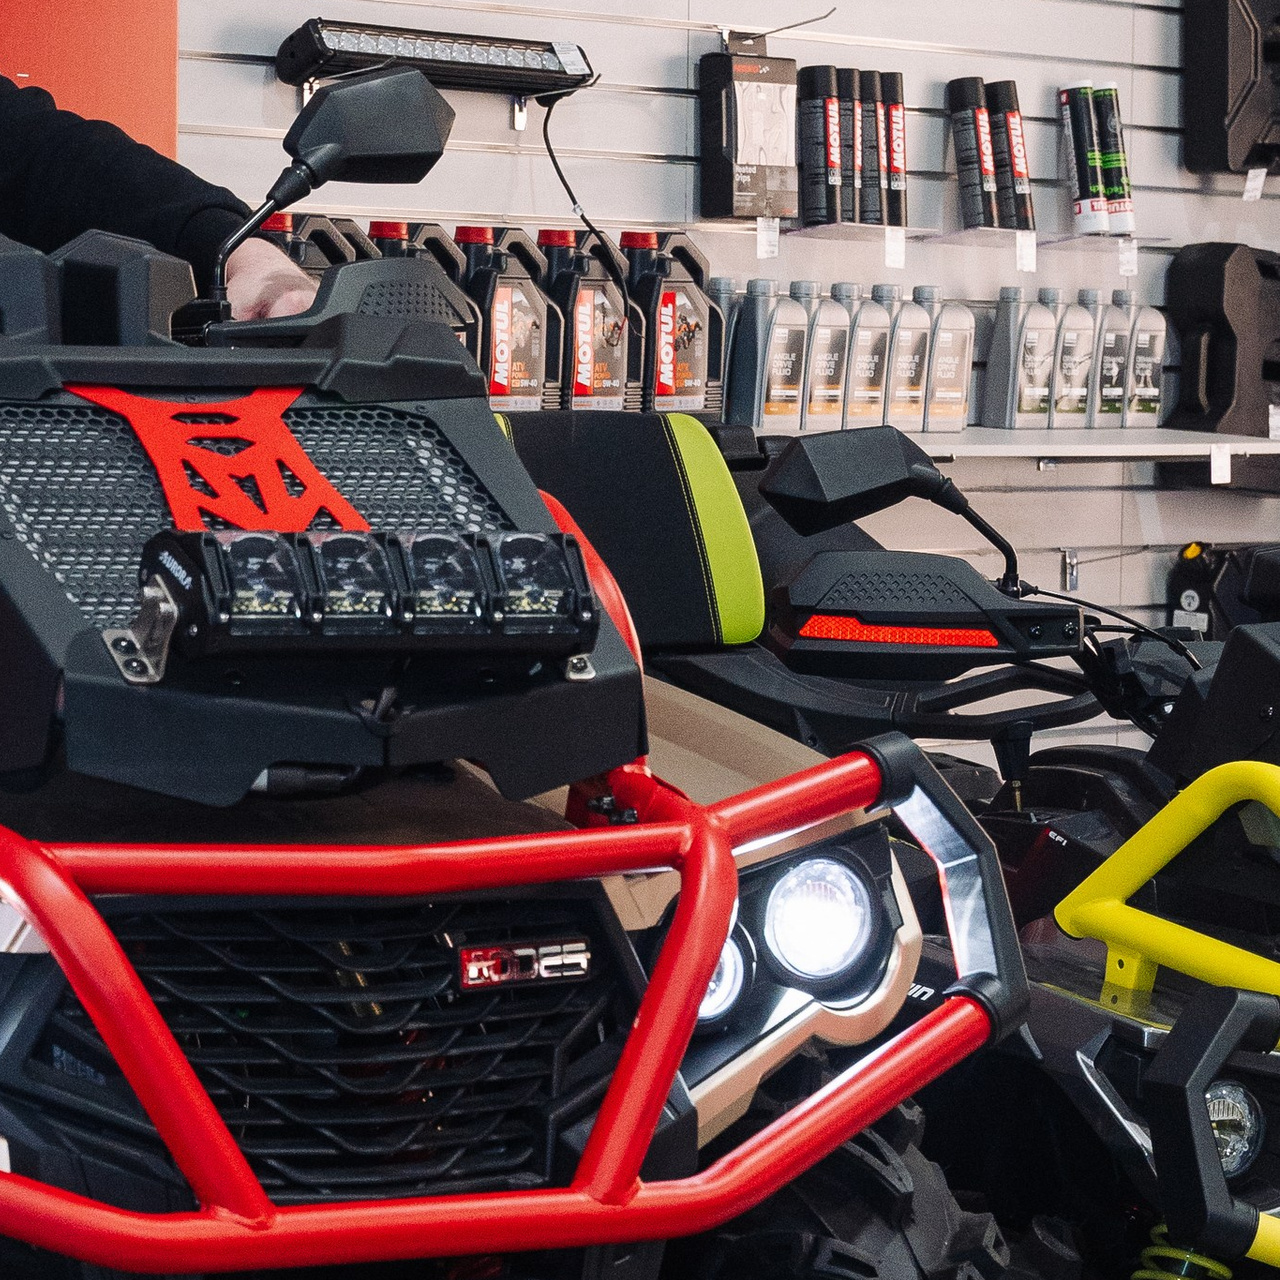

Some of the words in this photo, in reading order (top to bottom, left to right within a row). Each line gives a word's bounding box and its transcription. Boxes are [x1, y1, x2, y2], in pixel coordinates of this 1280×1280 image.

[828, 100, 841, 163] MOTUL
[891, 108, 904, 170] MOTUL
[978, 111, 994, 171] MOTUL
[1009, 115, 1027, 173] MOTUL
[494, 300, 509, 386] MOTUL
[577, 302, 591, 386] MOTUL
[660, 303, 673, 386] MOTUL
[1048, 830, 1068, 846] EFI
